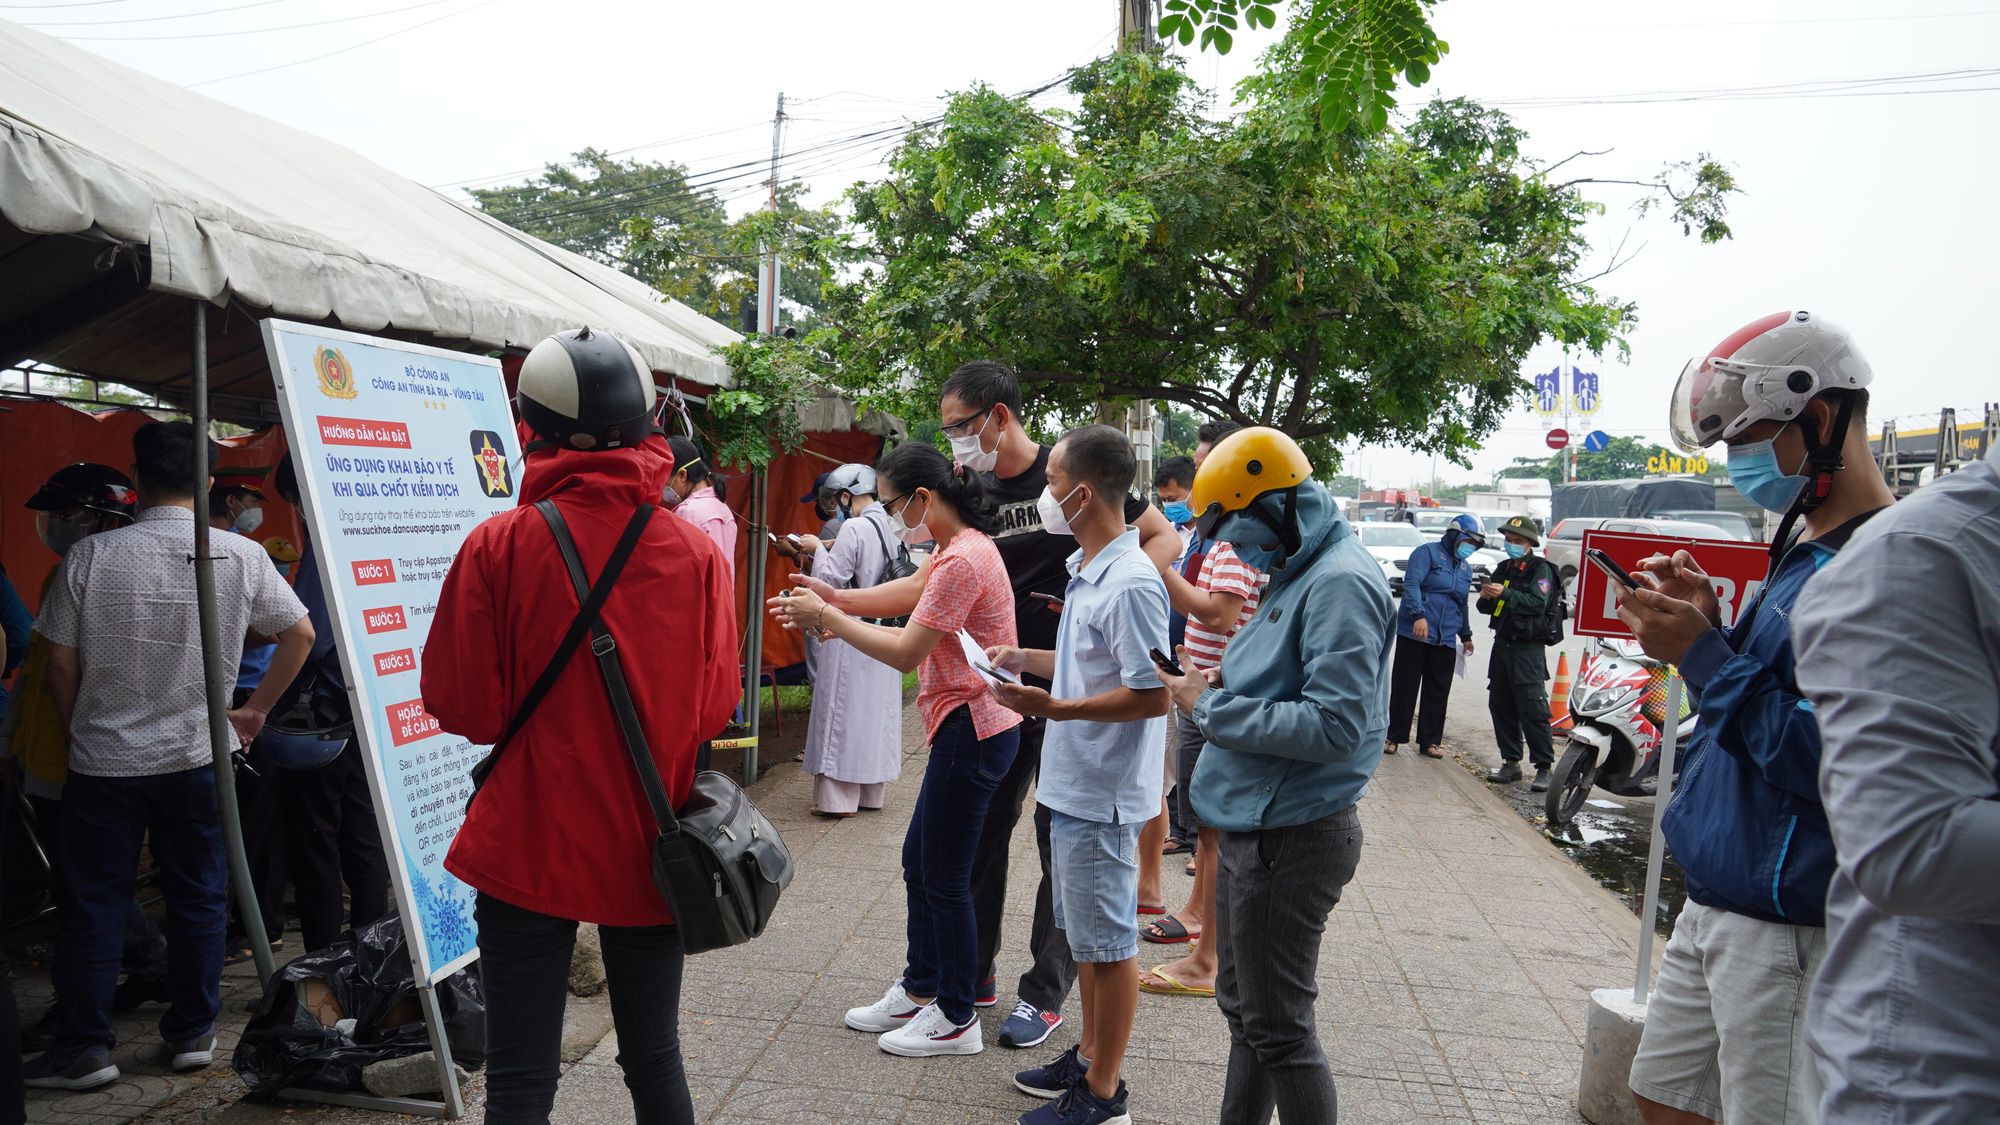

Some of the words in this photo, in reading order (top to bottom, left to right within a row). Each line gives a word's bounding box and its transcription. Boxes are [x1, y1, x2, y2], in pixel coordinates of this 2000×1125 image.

[405, 365, 416, 382] BỘ
[417, 367, 438, 381] CÔNG
[440, 372, 450, 382] AN
[372, 377, 396, 391] CÔNG
[398, 382, 408, 392] AN
[409, 378, 426, 395] TỈNH
[426, 384, 436, 396] BÀ
[437, 387, 448, 400] RỊA
[452, 387, 472, 400] VŨNG
[472, 389, 484, 402] TÀU
[322, 424, 355, 440] HƯỚNG
[356, 424, 375, 440] DẪN
[376, 428, 391, 442] CÀI
[391, 430, 406, 445] ĐẶT
[326, 453, 352, 472] ỨNG
[354, 458, 386, 477] DỤNG
[387, 460, 412, 474] KHAI
[414, 457, 434, 474] BÁO
[436, 462, 442, 474] Y
[444, 456, 454, 474] TẾ
[1648, 450, 1682, 474] CẦM
[332, 482, 353, 496] KHI
[354, 482, 380, 497] QUA
[380, 477, 409, 497] CHỐT
[411, 476, 434, 496] KIỂM
[436, 484, 460, 500] DỊCH
[338, 508, 354, 524] Ứng
[354, 510, 374, 523] dụng
[374, 510, 387, 522] này
[388, 509, 402, 522] thay
[403, 508, 414, 519] thế
[414, 509, 428, 519] khai
[428, 509, 441, 518] báo
[442, 508, 454, 518] trên
[342, 522, 460, 536] www.suckhoe.dancuquocgia.gov.vn
[358, 564, 382, 579] BƯỚC
[384, 566, 390, 576] 1
[398, 558, 412, 569] Truy
[414, 557, 426, 568] cập
[426, 556, 452, 567] Appstore
[402, 572, 418, 583] hoặc
[418, 572, 431, 582] truy
[432, 570, 442, 580] cập
[369, 611, 394, 628] BƯỚC
[394, 612, 401, 624] 2
[380, 654, 404, 670] BƯỚC
[404, 654, 411, 666] 3
[398, 704, 422, 721] HOẶC
[402, 720, 413, 738] ĐỂ
[414, 718, 428, 734] CÀI
[399, 760, 412, 770] Sau
[416, 753, 426, 765] khi
[428, 749, 438, 761] cài
[402, 774, 420, 787] đăng
[421, 769, 428, 782] ký
[430, 765, 442, 778] các
[444, 760, 460, 772] thông
[462, 756, 470, 766] tin
[470, 754, 478, 764] cơ
[406, 790, 415, 802] và
[416, 785, 430, 800] khai
[430, 782, 442, 794] báo
[444, 779, 452, 790] tại
[452, 774, 466, 786] mục
[446, 792, 456, 806] nội
[414, 820, 428, 834] đến
[428, 814, 444, 828] chốt.
[444, 809, 457, 822] Lưu
[418, 836, 430, 850] QR
[432, 832, 444, 844] cho
[446, 826, 458, 838] cán
[422, 852, 438, 866] dịch.
